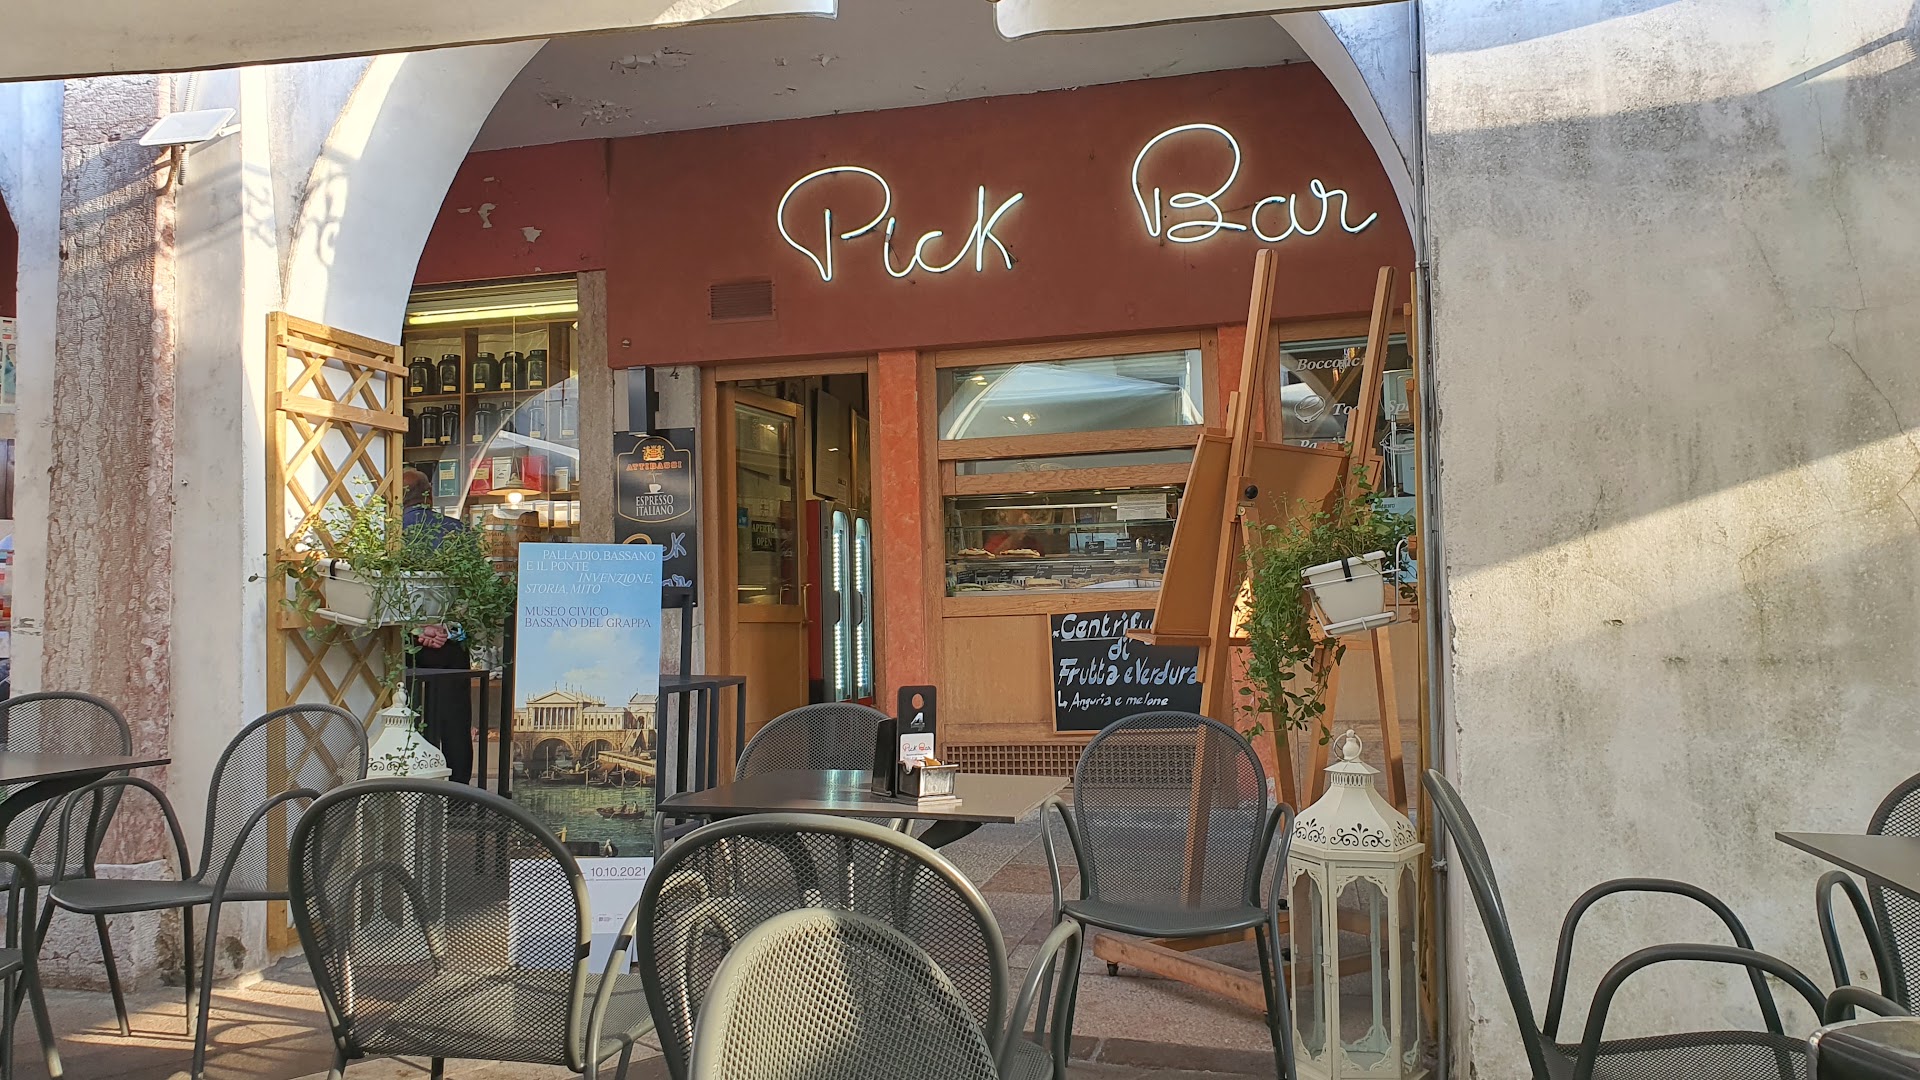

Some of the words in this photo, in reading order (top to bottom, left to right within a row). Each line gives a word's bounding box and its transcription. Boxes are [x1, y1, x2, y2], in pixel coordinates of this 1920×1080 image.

[1131, 122, 1379, 245] Bar
[669, 366, 680, 380] 4
[626, 460, 683, 472] ATTIBASSI
[635, 494, 675, 507] ESPRESSO
[635, 504, 675, 517] ITALIANO
[603, 550, 656, 562] BASSANO
[526, 560, 534, 571] E
[537, 560, 548, 571] IL
[551, 560, 590, 572] PONTE
[571, 583, 601, 594] MITO
[525, 606, 566, 617] MUSEO
[568, 606, 609, 617] CIVICO
[525, 617, 578, 628] BASSANO
[580, 617, 603, 628] DEL
[606, 617, 652, 628] GRAPPA
[1061, 611, 1153, 640] Centrifu
[1108, 636, 1130, 661] di
[1058, 656, 1120, 686] Frutta
[1123, 666, 1134, 684] e
[1135, 656, 1198, 685] Verdura
[1068, 691, 1112, 713] Anguria
[1114, 697, 1123, 707] e
[1125, 692, 1169, 706] melone
[910, 712, 926, 732] 4
[590, 866, 646, 877] 10.10.2021
